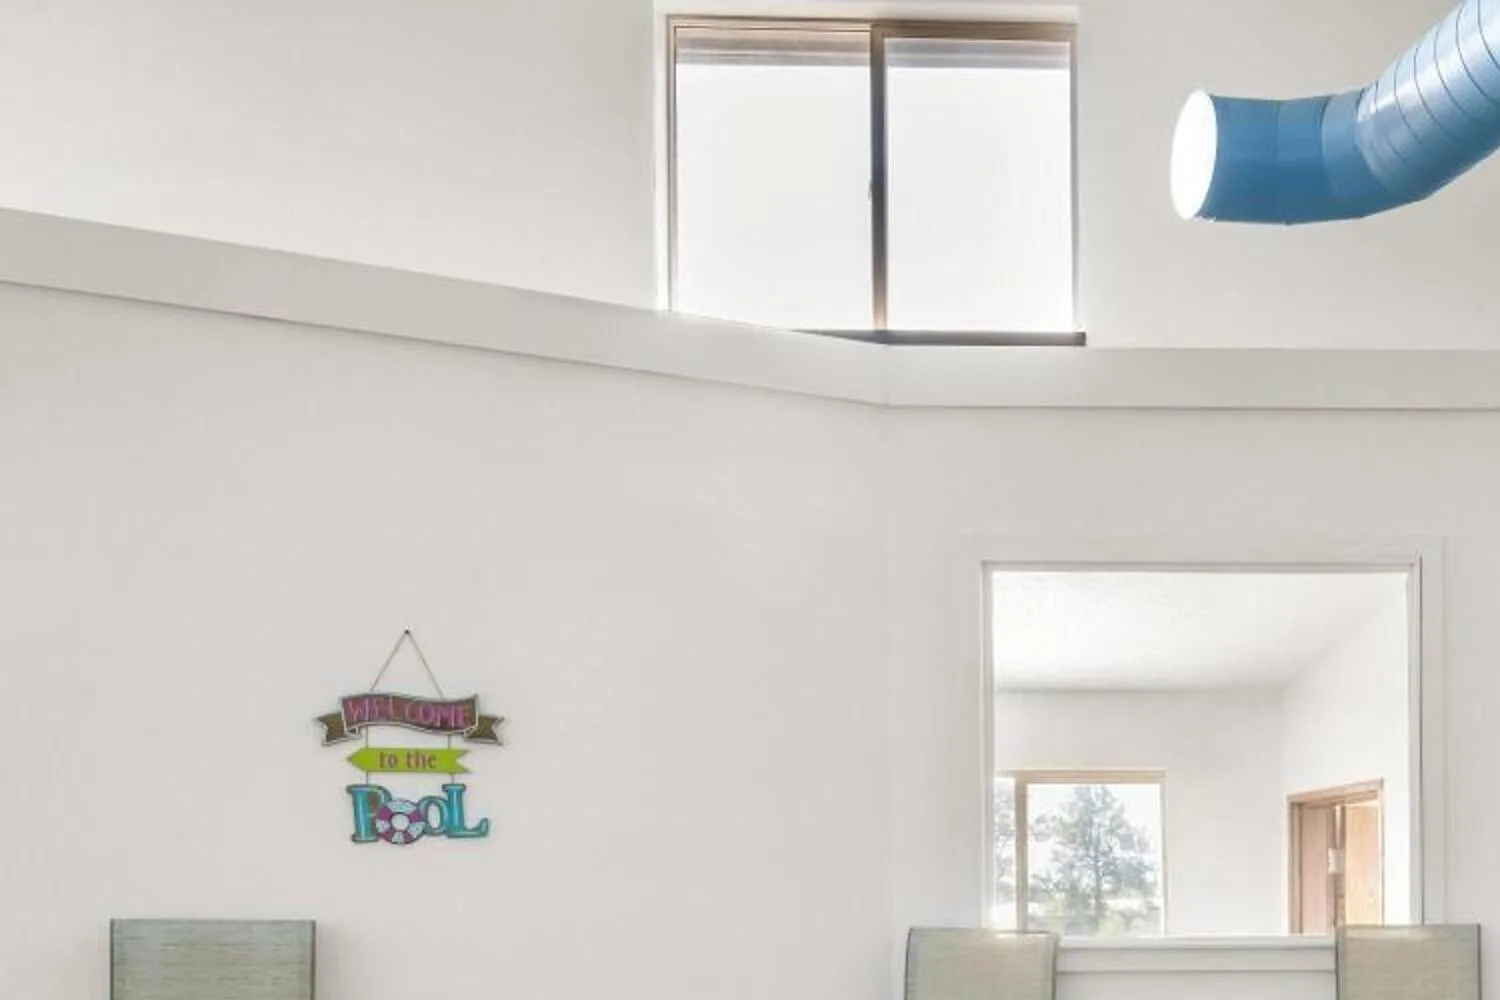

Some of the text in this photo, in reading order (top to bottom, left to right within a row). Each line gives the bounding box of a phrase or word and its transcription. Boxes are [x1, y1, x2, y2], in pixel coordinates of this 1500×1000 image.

[347, 695, 470, 730] WELCOME
[379, 751, 437, 768] to the
